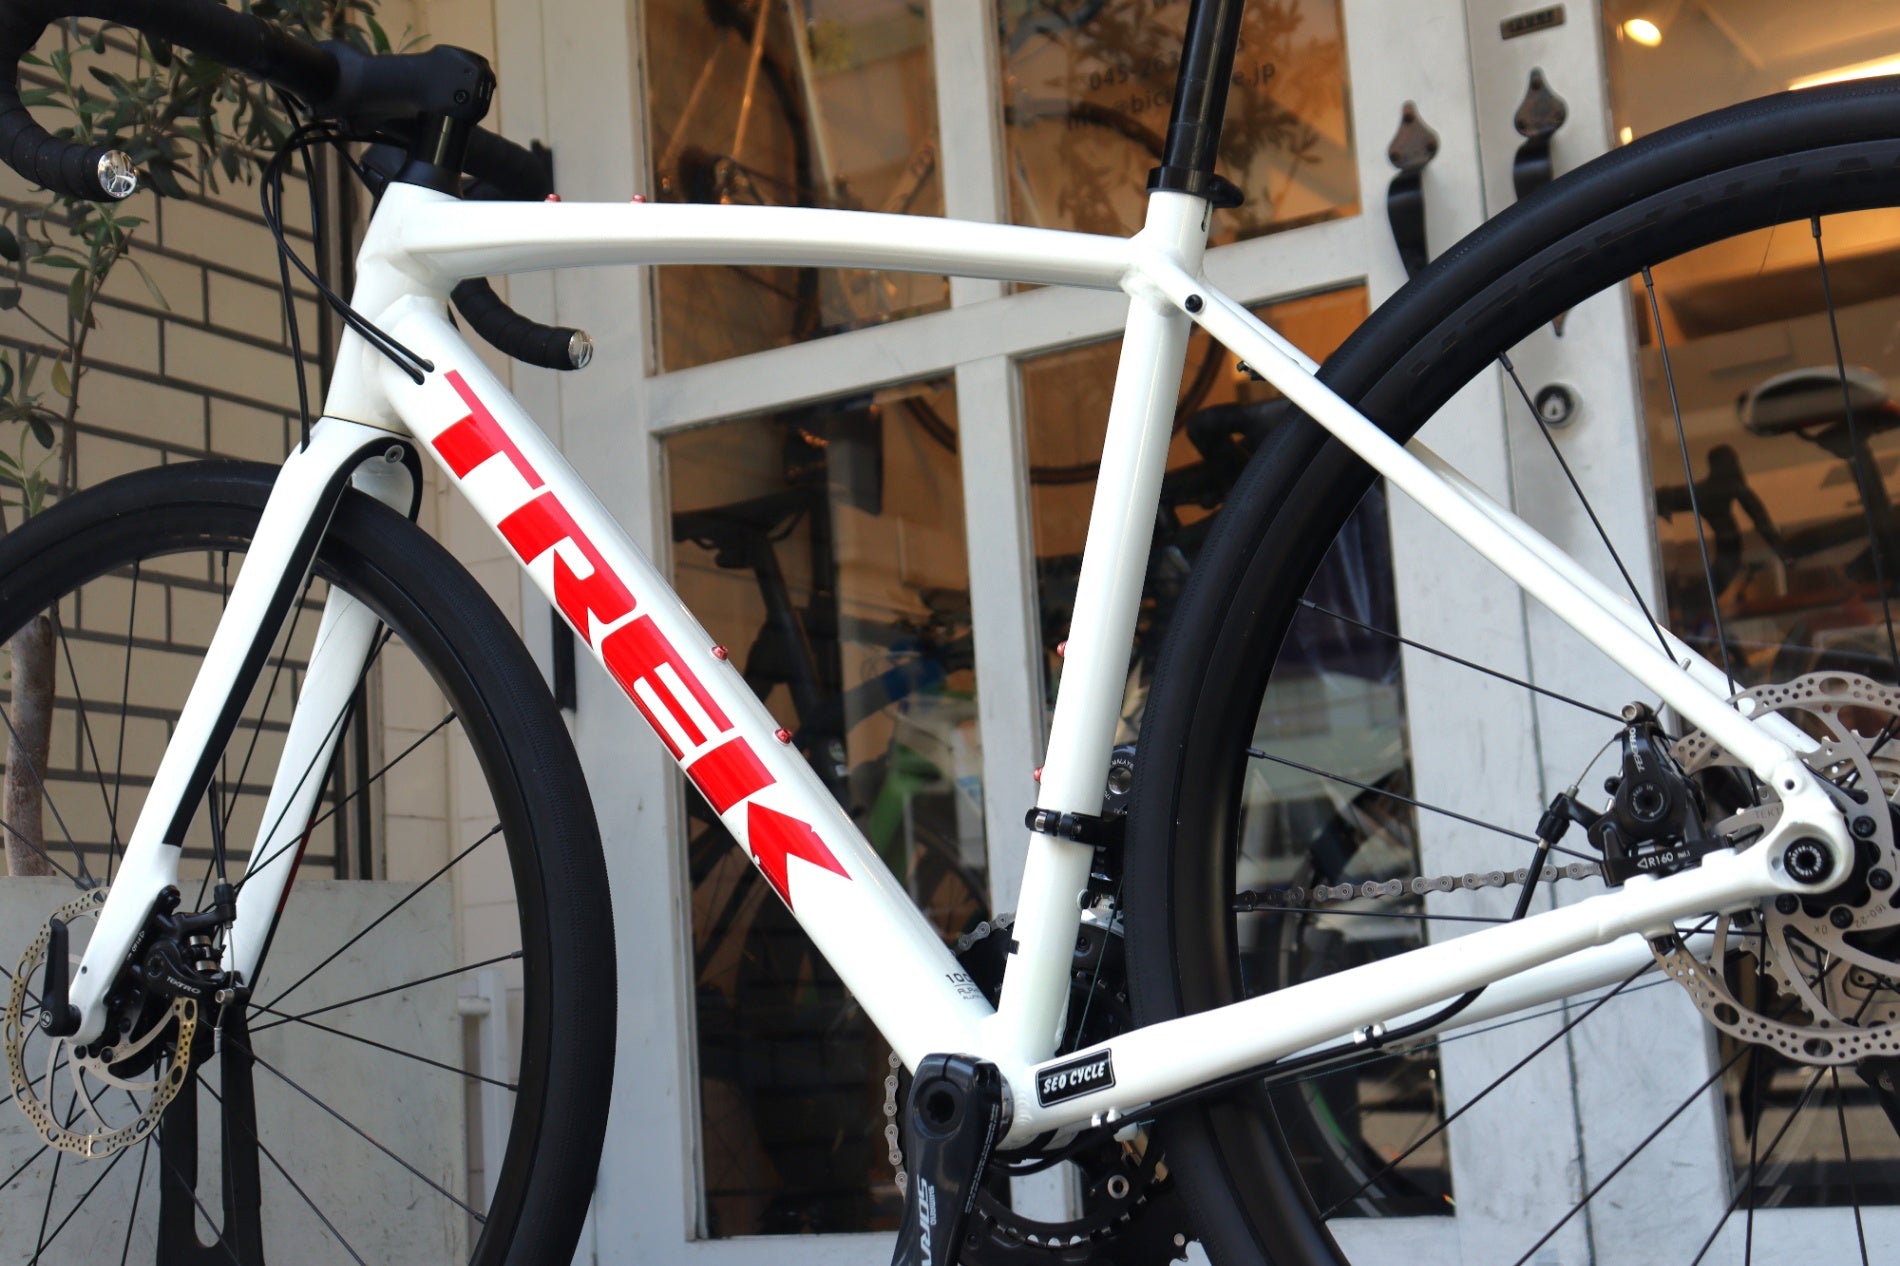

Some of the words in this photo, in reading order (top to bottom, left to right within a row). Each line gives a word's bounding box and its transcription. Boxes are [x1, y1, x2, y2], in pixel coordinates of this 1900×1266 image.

[431, 370, 852, 914] TREK
[1648, 852, 1674, 867] R160
[166, 976, 201, 994] TEKTRO
[1043, 1074, 1067, 1094] SEO
[1069, 1062, 1105, 1086] CYCLE
[928, 1185, 937, 1226] SHIMANO
